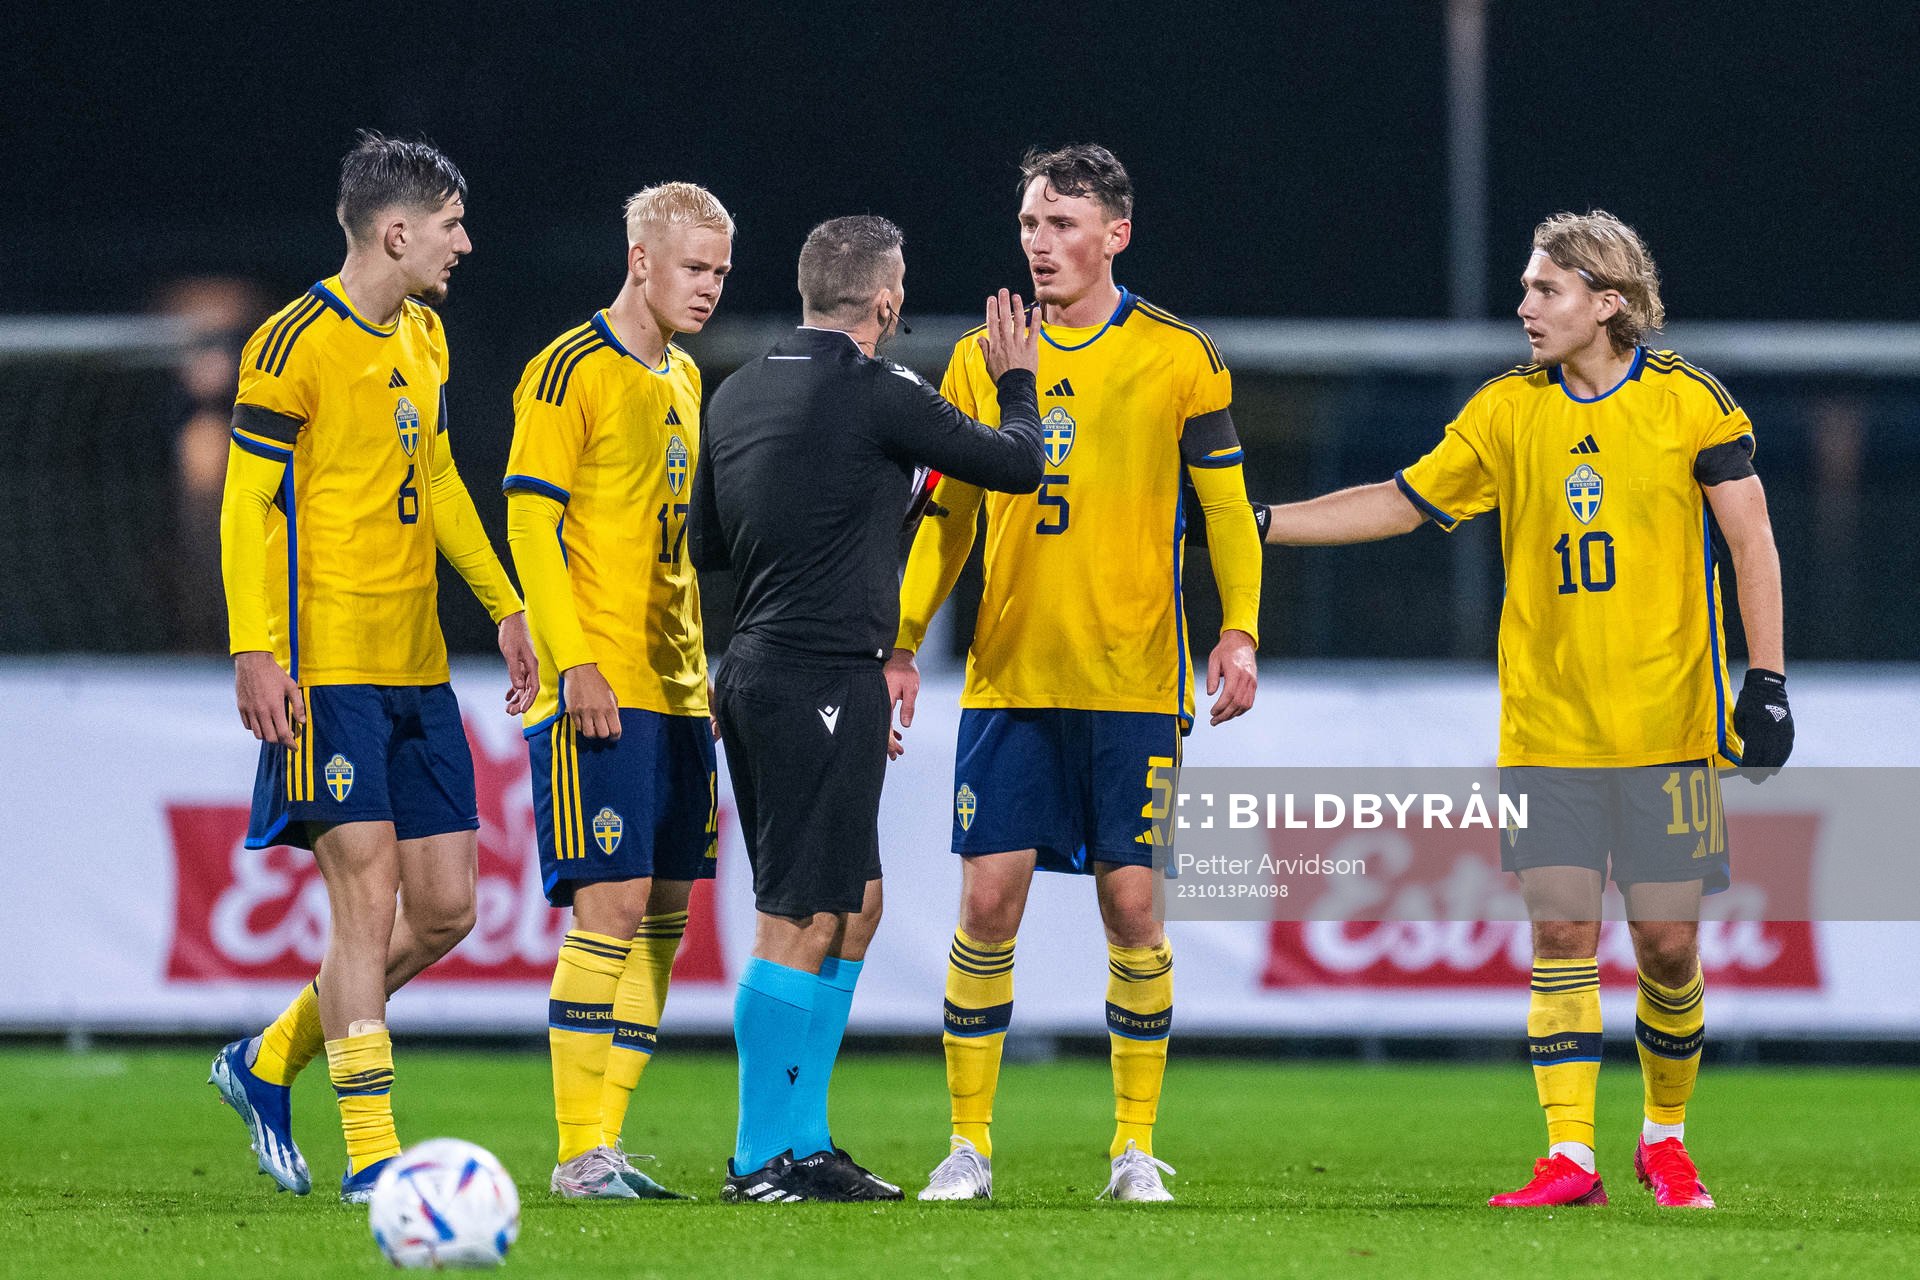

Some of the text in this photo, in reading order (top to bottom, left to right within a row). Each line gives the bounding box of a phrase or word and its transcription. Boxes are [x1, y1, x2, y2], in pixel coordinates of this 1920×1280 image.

[397, 464, 419, 525] 6
[1035, 474, 1070, 535] 5
[657, 503, 690, 564] 17
[1553, 531, 1617, 595] 10
[1141, 756, 1174, 820] 5
[1662, 769, 1709, 835] 10
